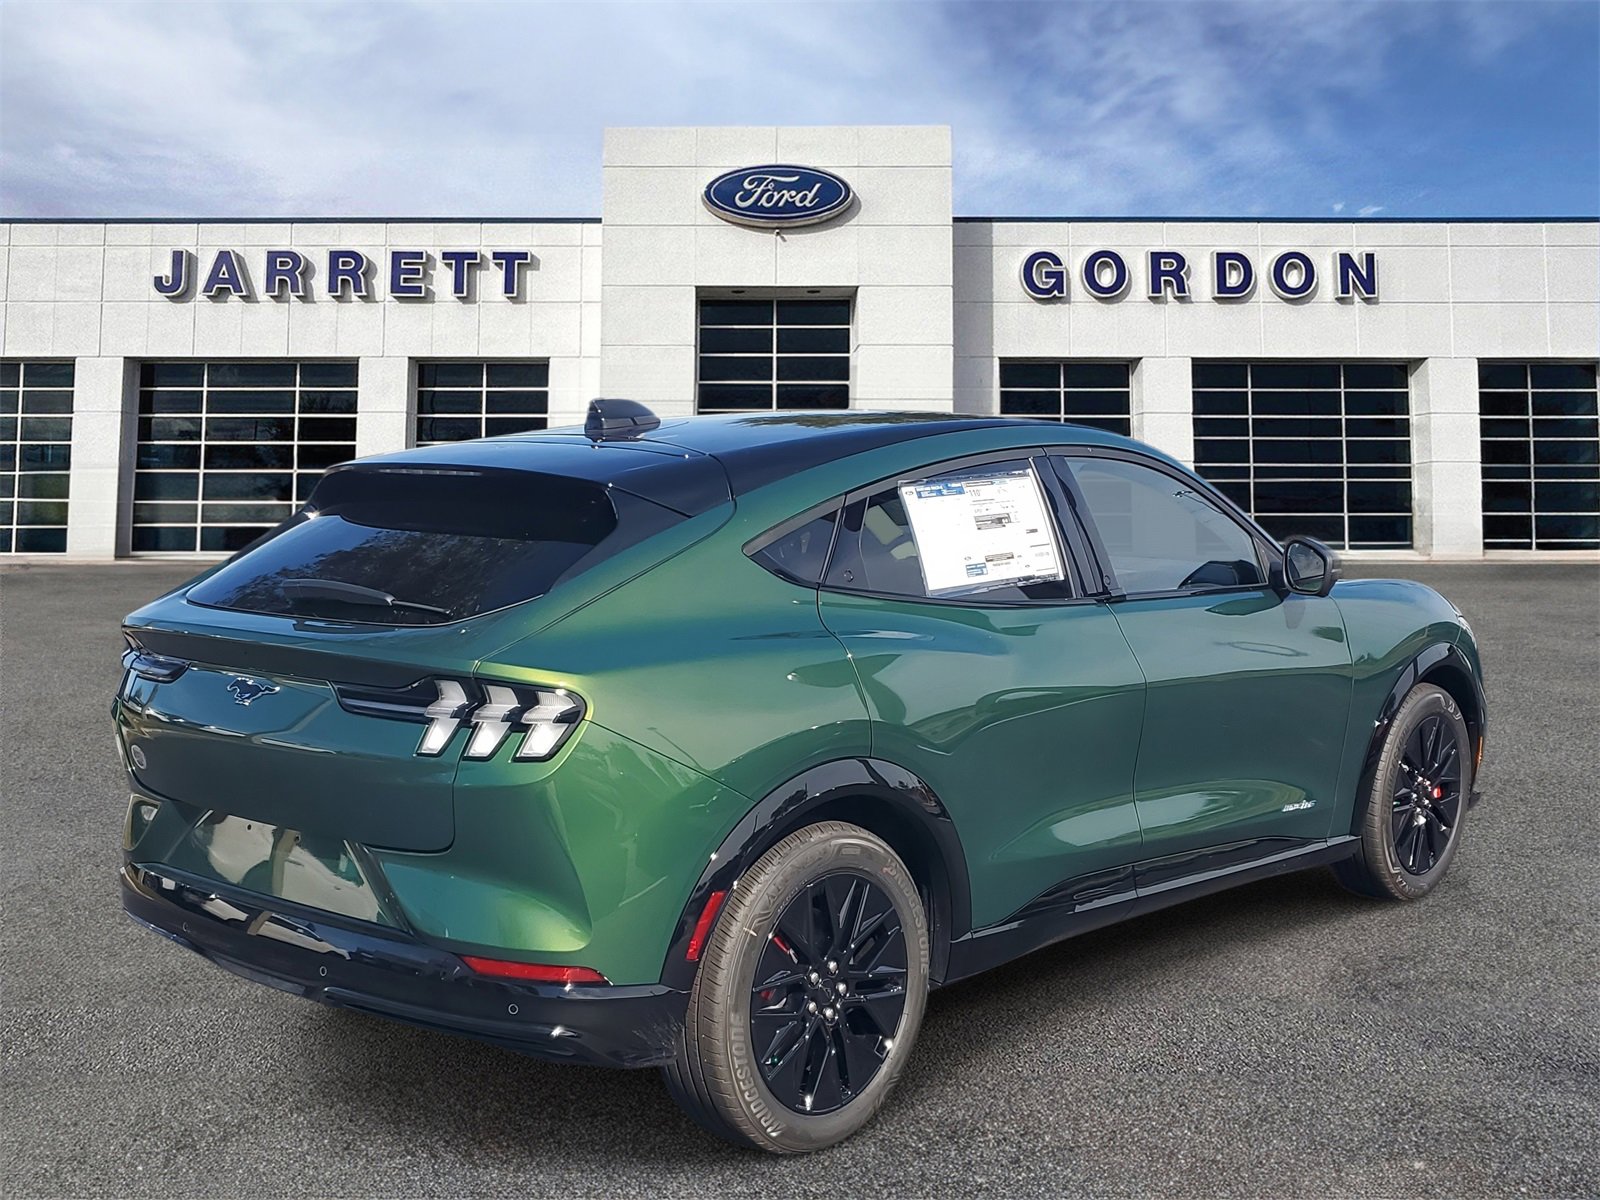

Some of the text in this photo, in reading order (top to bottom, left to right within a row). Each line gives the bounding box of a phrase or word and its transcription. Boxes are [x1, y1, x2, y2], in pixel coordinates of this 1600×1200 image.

[734, 174, 822, 208] Ford
[153, 249, 532, 299] JARRETT
[1020, 249, 1380, 301] GORDON
[730, 1012, 787, 1137] BRIDGESTONE
